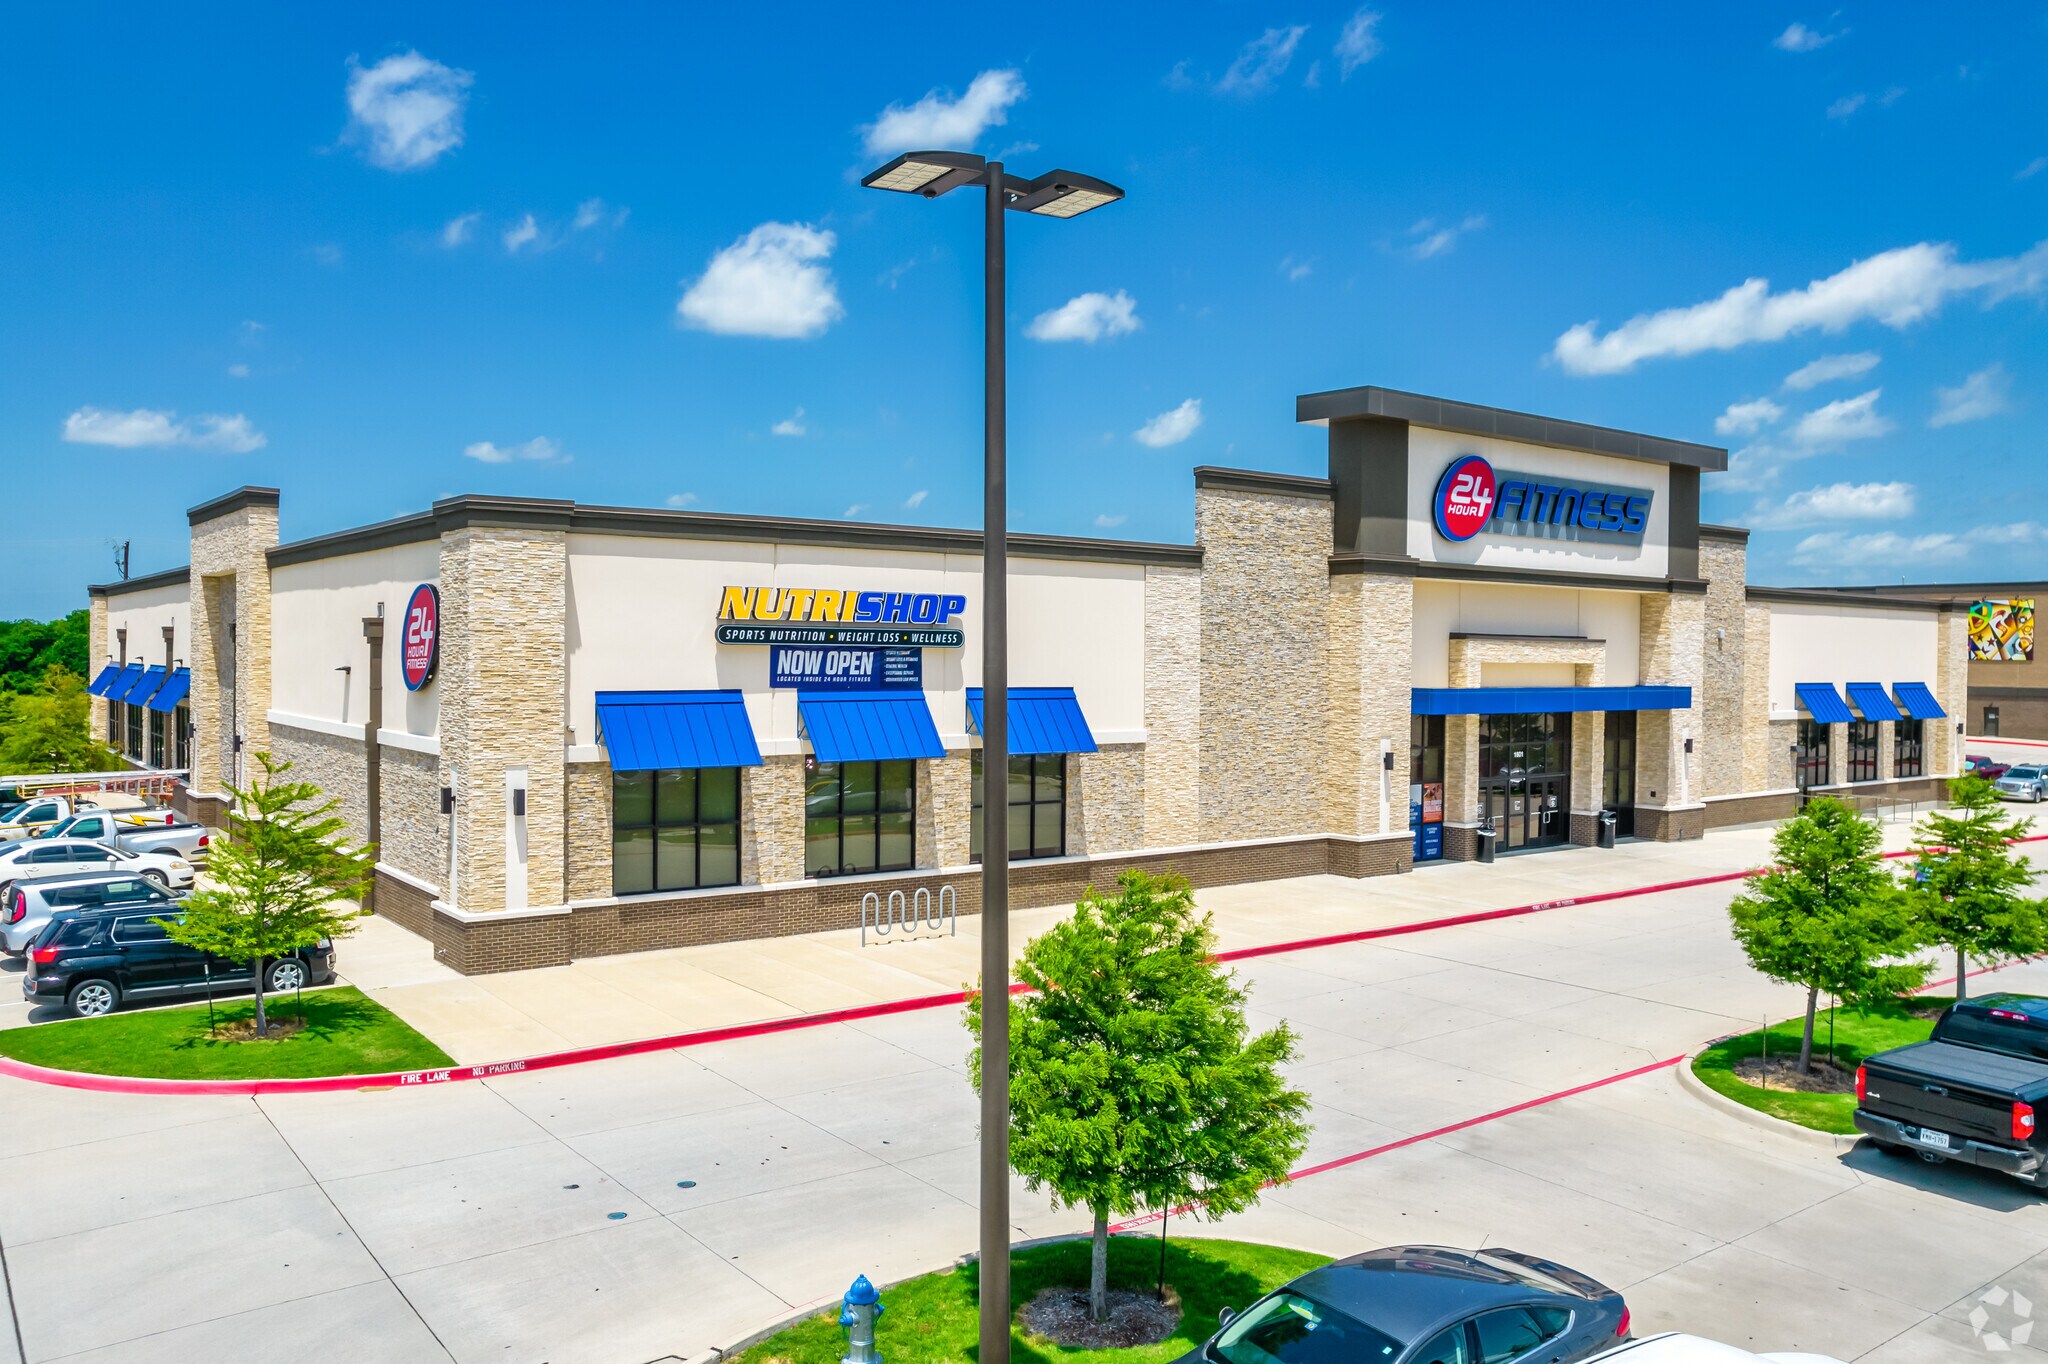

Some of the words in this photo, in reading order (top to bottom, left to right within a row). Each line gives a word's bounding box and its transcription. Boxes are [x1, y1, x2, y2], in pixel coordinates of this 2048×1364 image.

[1451, 474, 1492, 517] 24
[1495, 480, 1649, 533] FITNESS
[1447, 503, 1477, 517] HOUR
[718, 586, 967, 625] NUTRISHOP
[409, 606, 434, 656] 24
[725, 629, 765, 640] SPORTS
[770, 630, 826, 642] NUTRITION
[838, 632, 874, 642] WEIGHT
[877, 633, 900, 642] LOSS
[911, 634, 958, 643] WELLNESS
[408, 645, 425, 657] HOUR
[777, 650, 823, 675] NOW
[825, 650, 874, 675] OPEN
[407, 658, 428, 669] FITNESS
[401, 1073, 422, 1084] FIRE
[426, 1070, 451, 1082] LANE
[472, 1066, 485, 1076] NO
[489, 1061, 526, 1074] PARKING
[1120, 1215, 1159, 1229] PARKING
